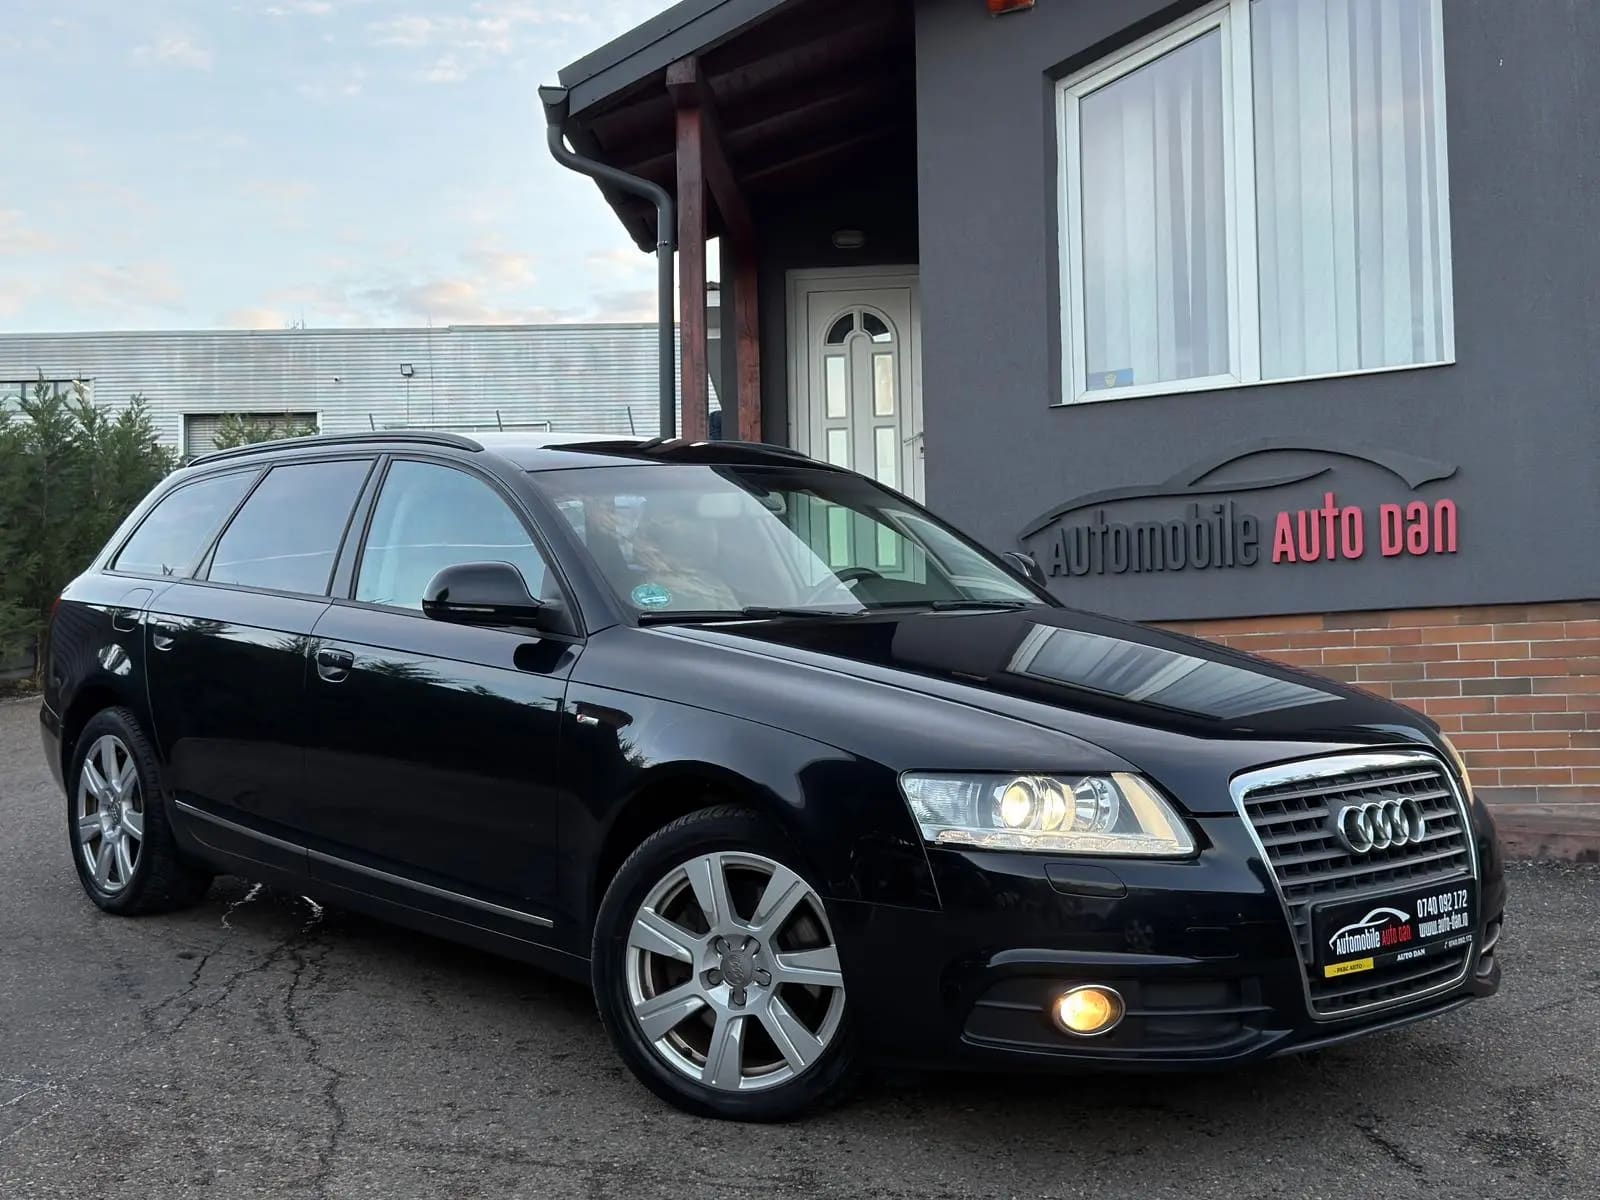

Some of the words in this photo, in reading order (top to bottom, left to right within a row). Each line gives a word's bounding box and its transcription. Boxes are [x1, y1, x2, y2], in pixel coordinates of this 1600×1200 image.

[1048, 498, 1260, 578] Automobile
[1272, 492, 1364, 564] Auto
[1417, 896, 1438, 918] 0740
[1438, 893, 1453, 913] 092
[1453, 889, 1468, 909] 172
[1336, 927, 1381, 956] Automobile
[1396, 951, 1413, 961] AUTO
[1413, 948, 1426, 957] DAN
